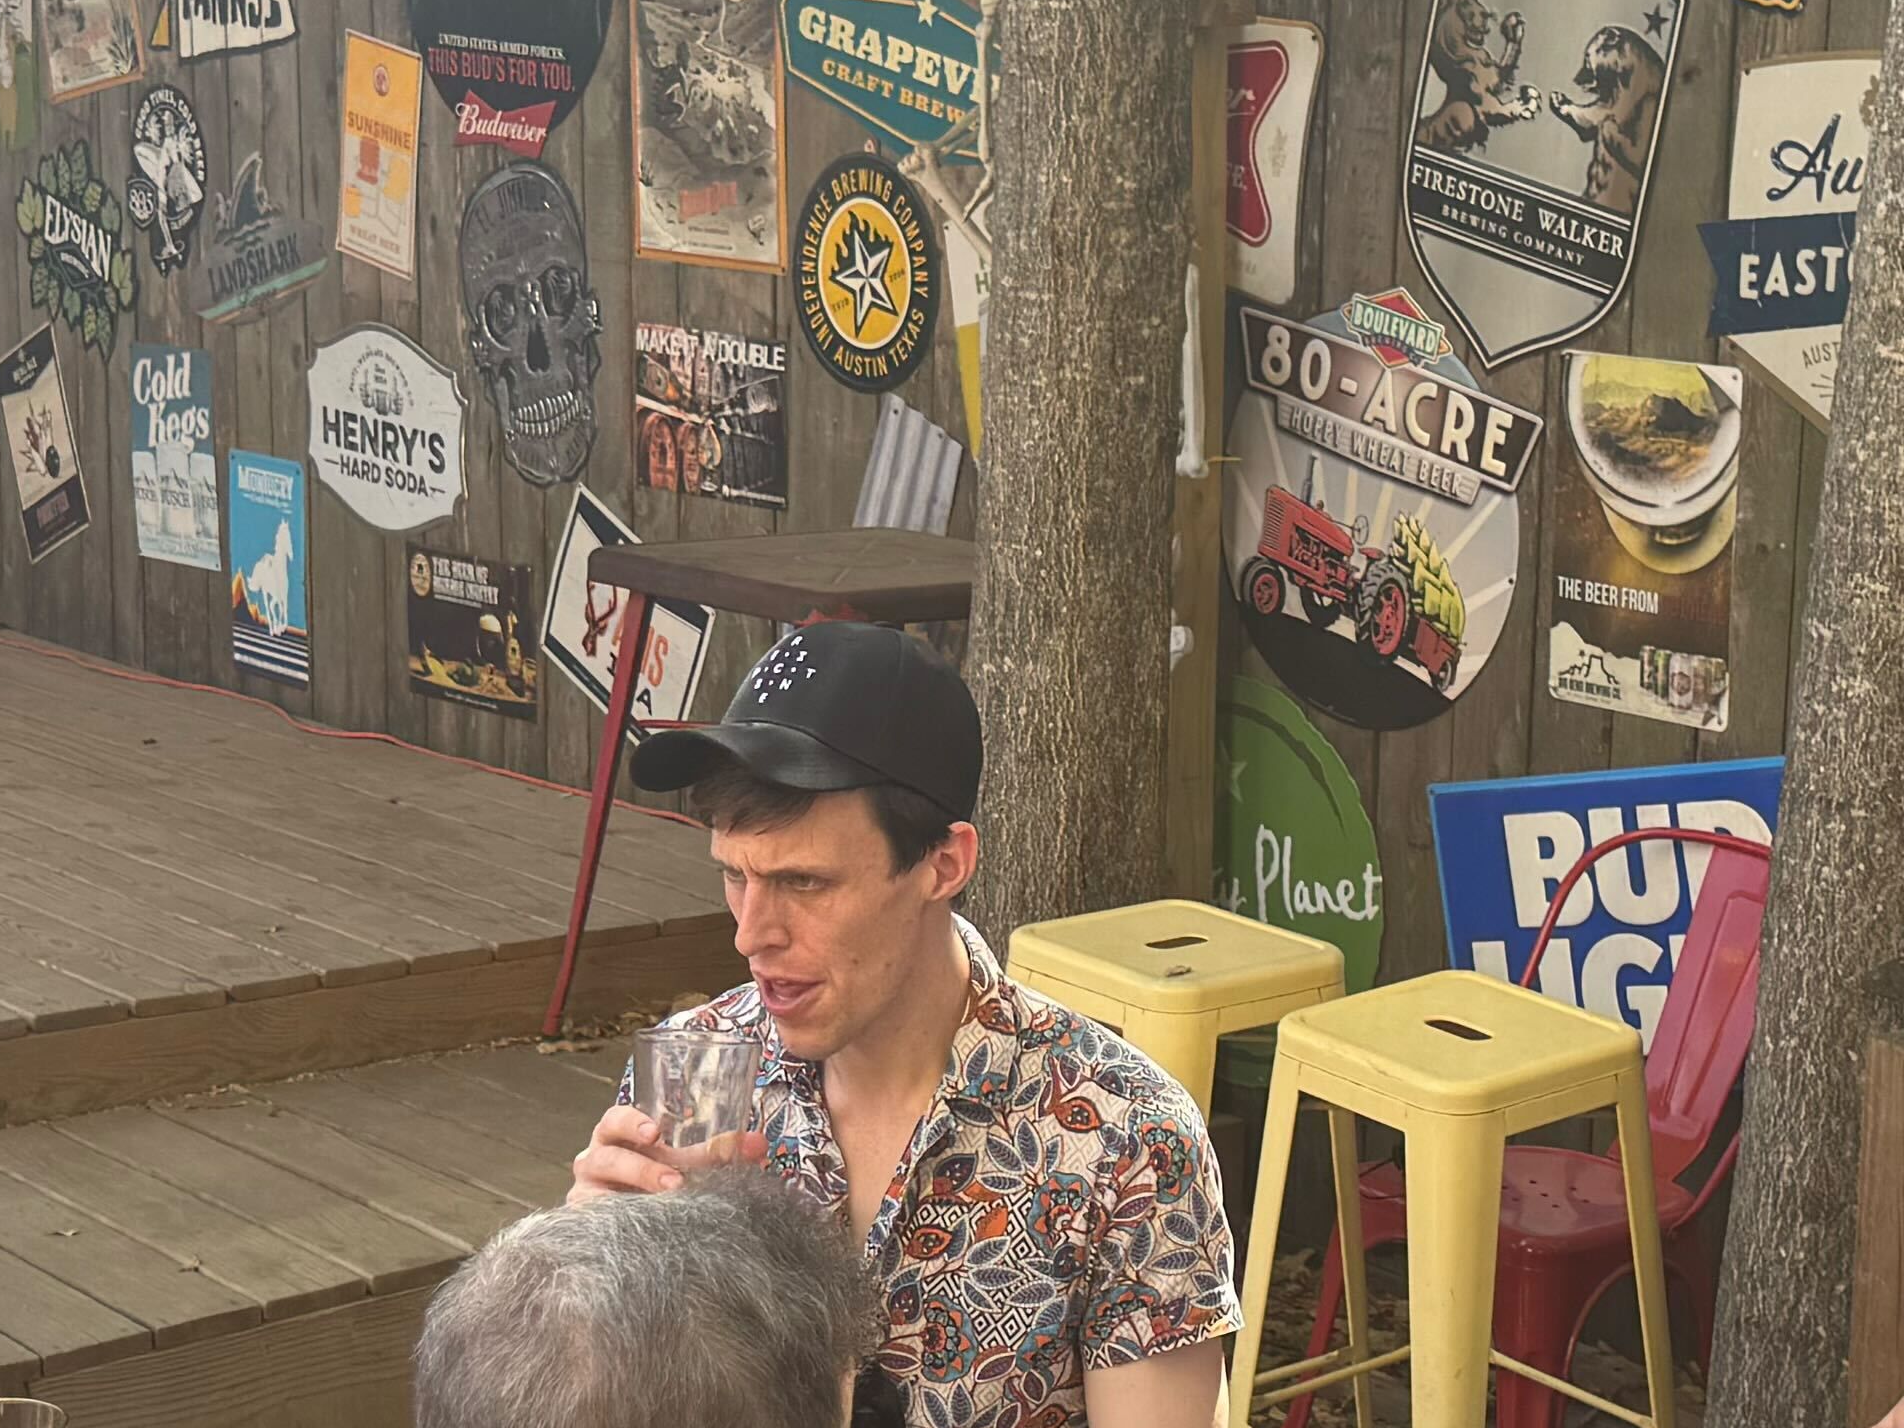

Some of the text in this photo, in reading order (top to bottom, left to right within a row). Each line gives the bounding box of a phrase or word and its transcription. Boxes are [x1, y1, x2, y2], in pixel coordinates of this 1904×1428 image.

[428, 47, 576, 93] THIS BUD'S FOR YOU.
[438, 33, 467, 48] UNITED
[468, 37, 497, 52] STATES
[498, 40, 528, 55] ARMED
[822, 57, 894, 100] CRAFT
[347, 110, 413, 150] SUNSHINE
[456, 99, 548, 144] Budweiser
[128, 188, 154, 221] 805
[1411, 163, 1625, 260] FIRESTONE WALKER
[44, 193, 112, 283] ELYSIAN
[801, 168, 929, 352] INDEPENDENCE BREWING COMPANY
[1441, 204, 1586, 268] BREWING COMPANY
[206, 234, 303, 295] LANDSHARK
[1739, 243, 1855, 303] EAST
[636, 326, 681, 356] MAKE
[717, 338, 786, 371] DOUBLE
[833, 308, 925, 378] AUSTIN TEXAS
[1353, 302, 1436, 353] BOULEVARD
[132, 350, 191, 406] Cold
[1260, 324, 1515, 477] 80-ACRE
[147, 403, 210, 454] Kegs
[321, 405, 446, 474] HENRY'S
[1290, 406, 1464, 500] HOPPY WHEAT BEER
[340, 462, 430, 497] HARD SODA
[1557, 575, 1659, 615] THE BEER FROM
[1255, 823, 1384, 924] Planet
